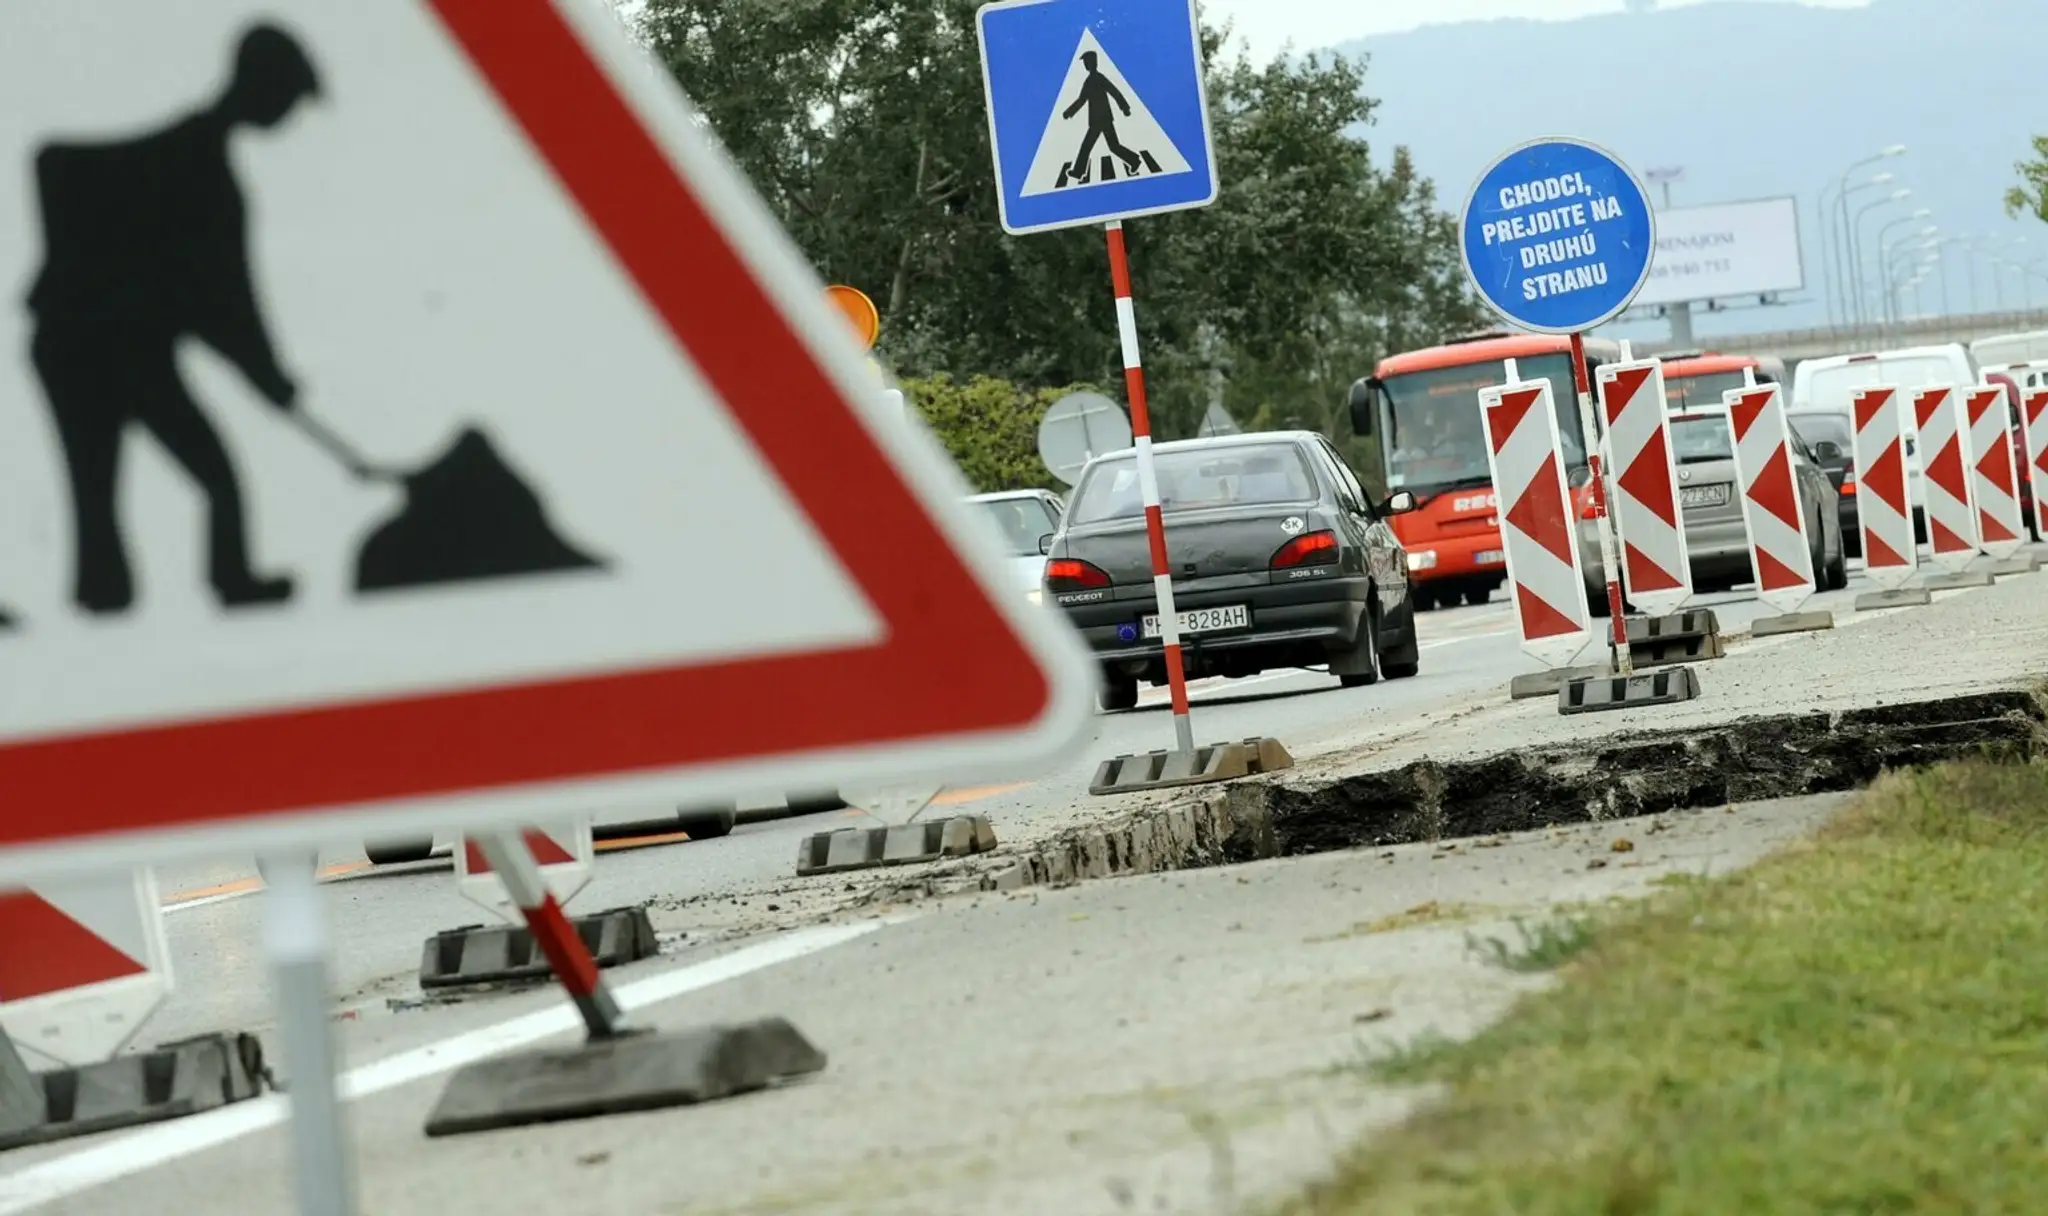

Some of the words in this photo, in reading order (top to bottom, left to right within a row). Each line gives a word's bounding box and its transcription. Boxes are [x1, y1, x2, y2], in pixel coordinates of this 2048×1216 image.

[1500, 171, 1592, 210] CHODCI,
[1481, 203, 1587, 246] PREJDITE
[1590, 195, 1623, 222] NA
[1520, 228, 1597, 269] DRUHÚ
[1522, 262, 1608, 300] STRANU
[1284, 519, 1299, 530] SK
[1058, 592, 1103, 603] PEUGEOT
